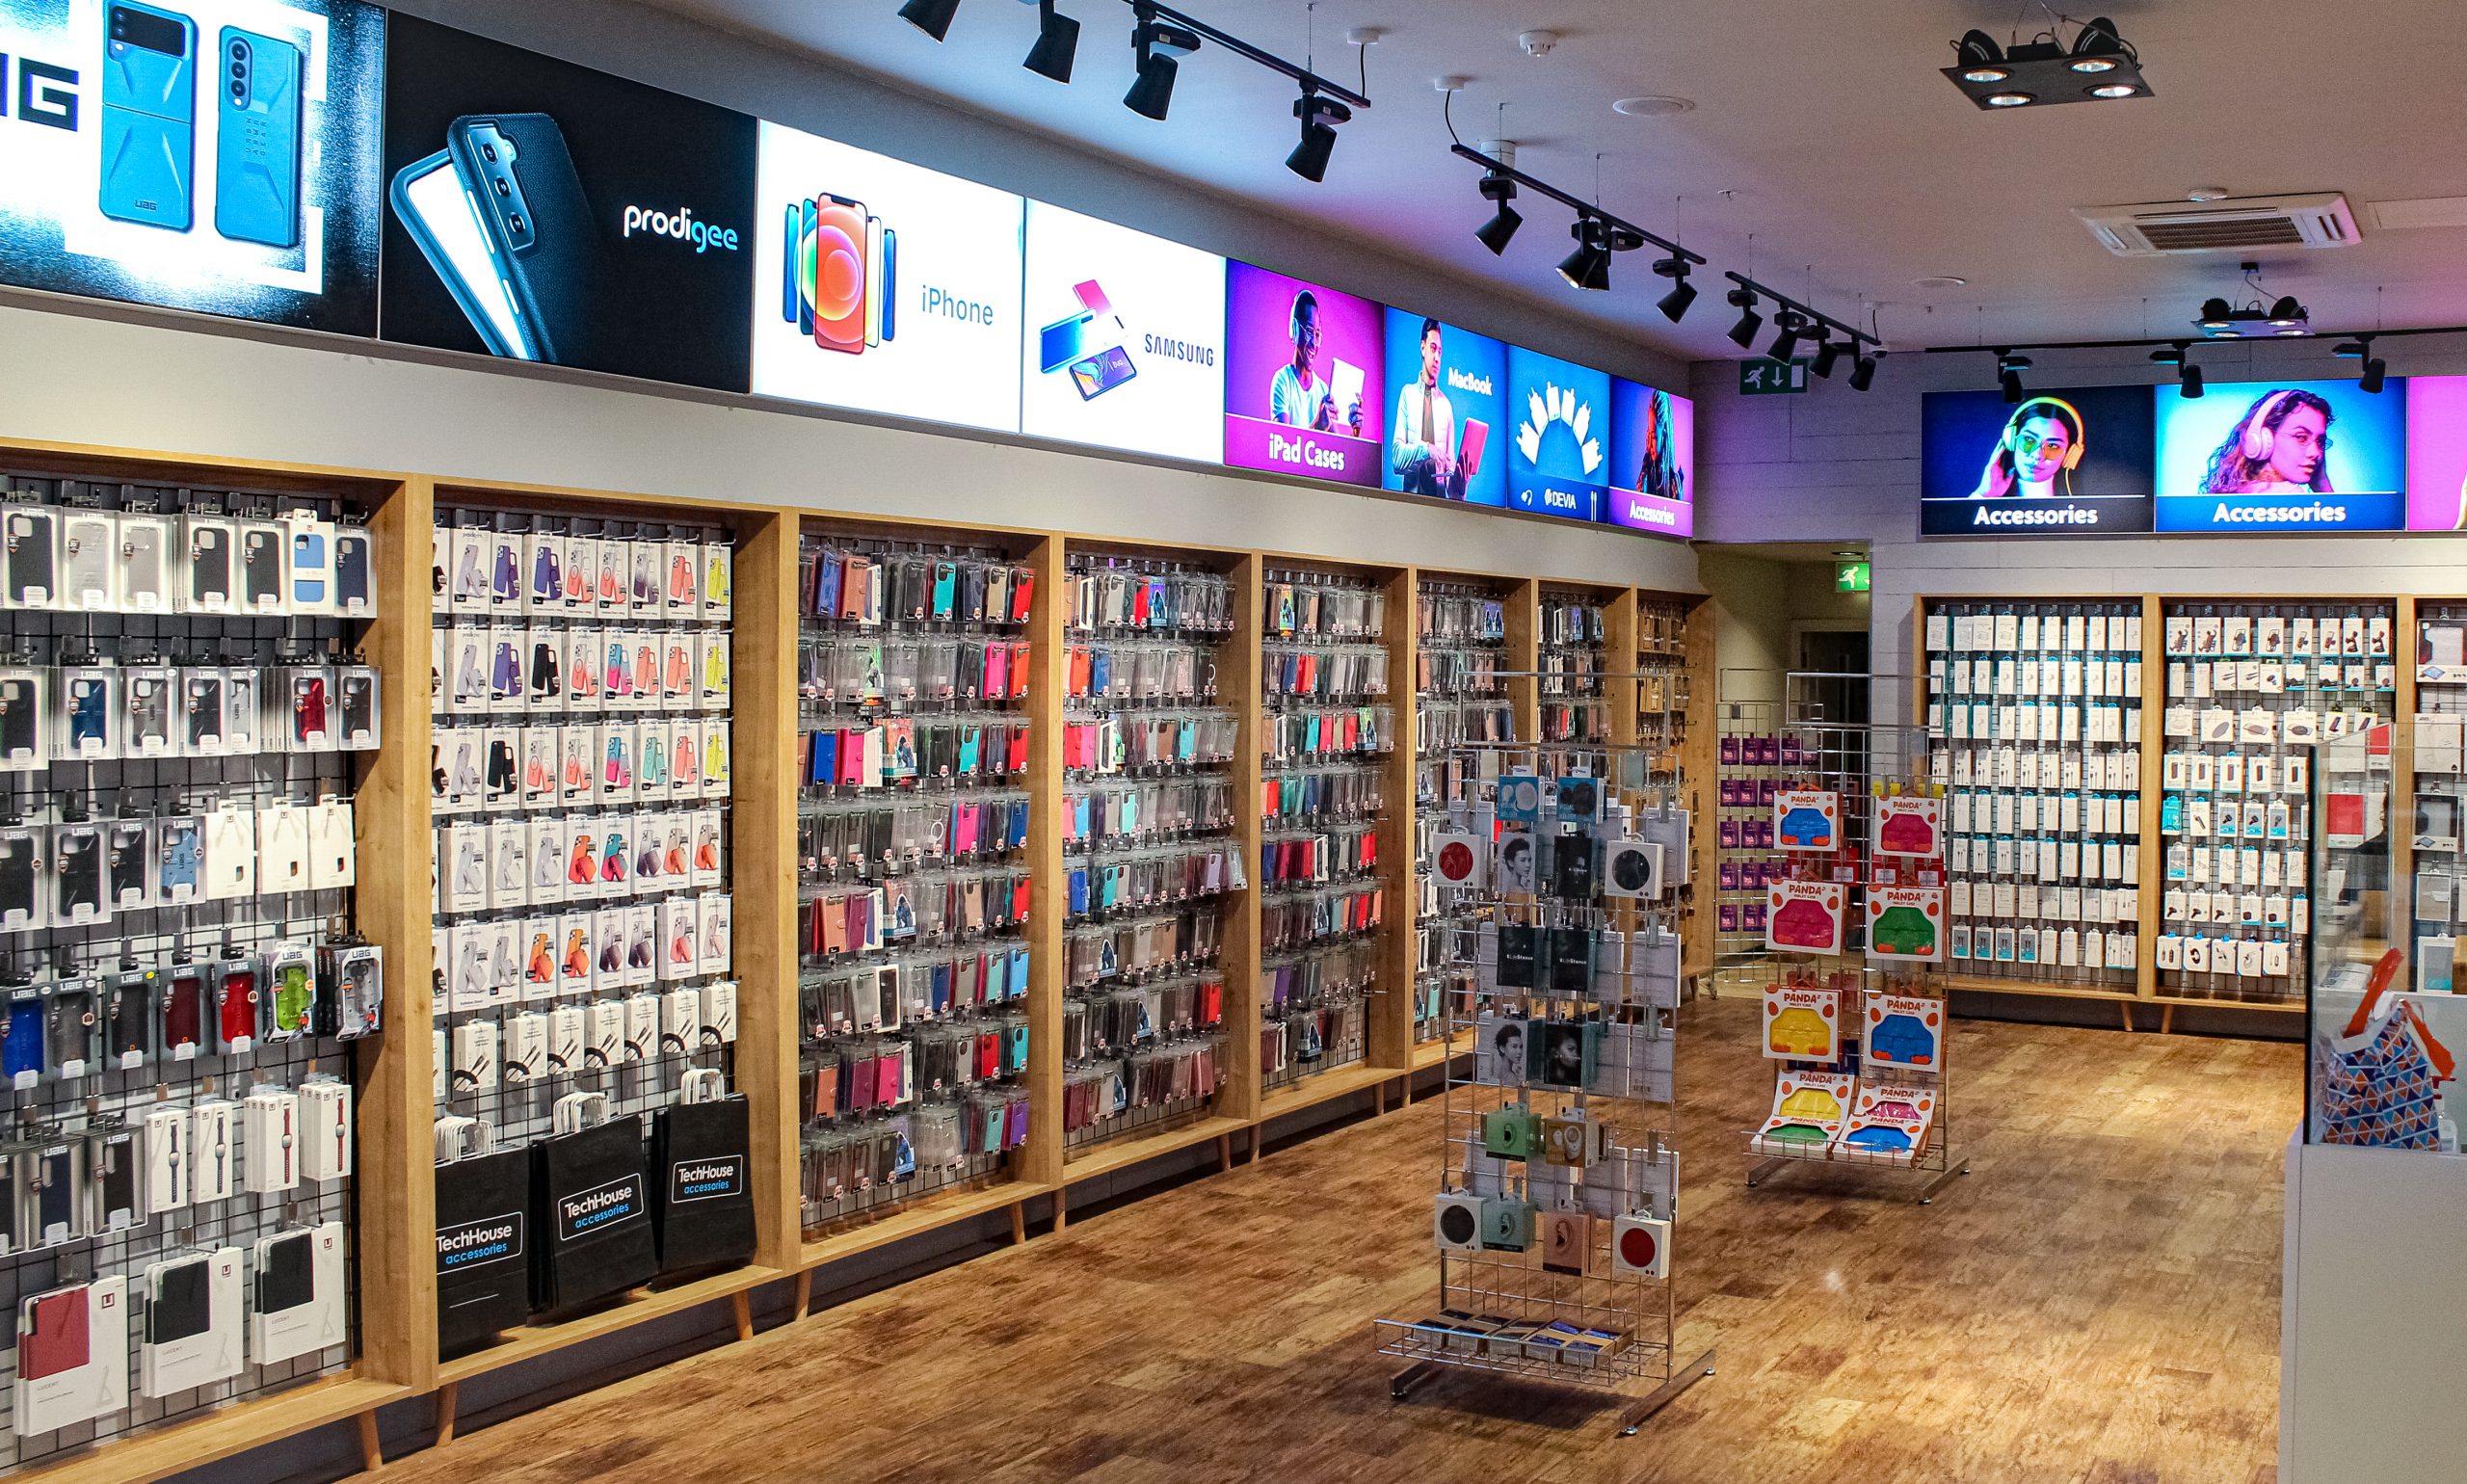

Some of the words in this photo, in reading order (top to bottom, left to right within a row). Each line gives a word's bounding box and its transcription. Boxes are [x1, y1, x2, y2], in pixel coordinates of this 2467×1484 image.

[0, 53, 79, 131] G
[623, 204, 738, 252] prodigee
[921, 284, 994, 327] iPhone
[1145, 333, 1214, 367] SAMSUNG
[1447, 367, 1493, 397] MacBook
[1268, 433, 1303, 464] iPad
[1305, 441, 1345, 472] Cases
[1552, 490, 1577, 510] DEVIA
[1629, 499, 1676, 527] Accessories
[2213, 500, 2347, 523] Accessories
[1974, 504, 2099, 526] Accessories
[678, 1164, 734, 1183] TechHouse
[683, 1179, 729, 1195] accessories
[565, 1184, 632, 1219] TechHouse
[574, 1202, 629, 1229] accessories
[436, 1223, 513, 1253] TechHouse
[445, 1241, 508, 1265] accessories
